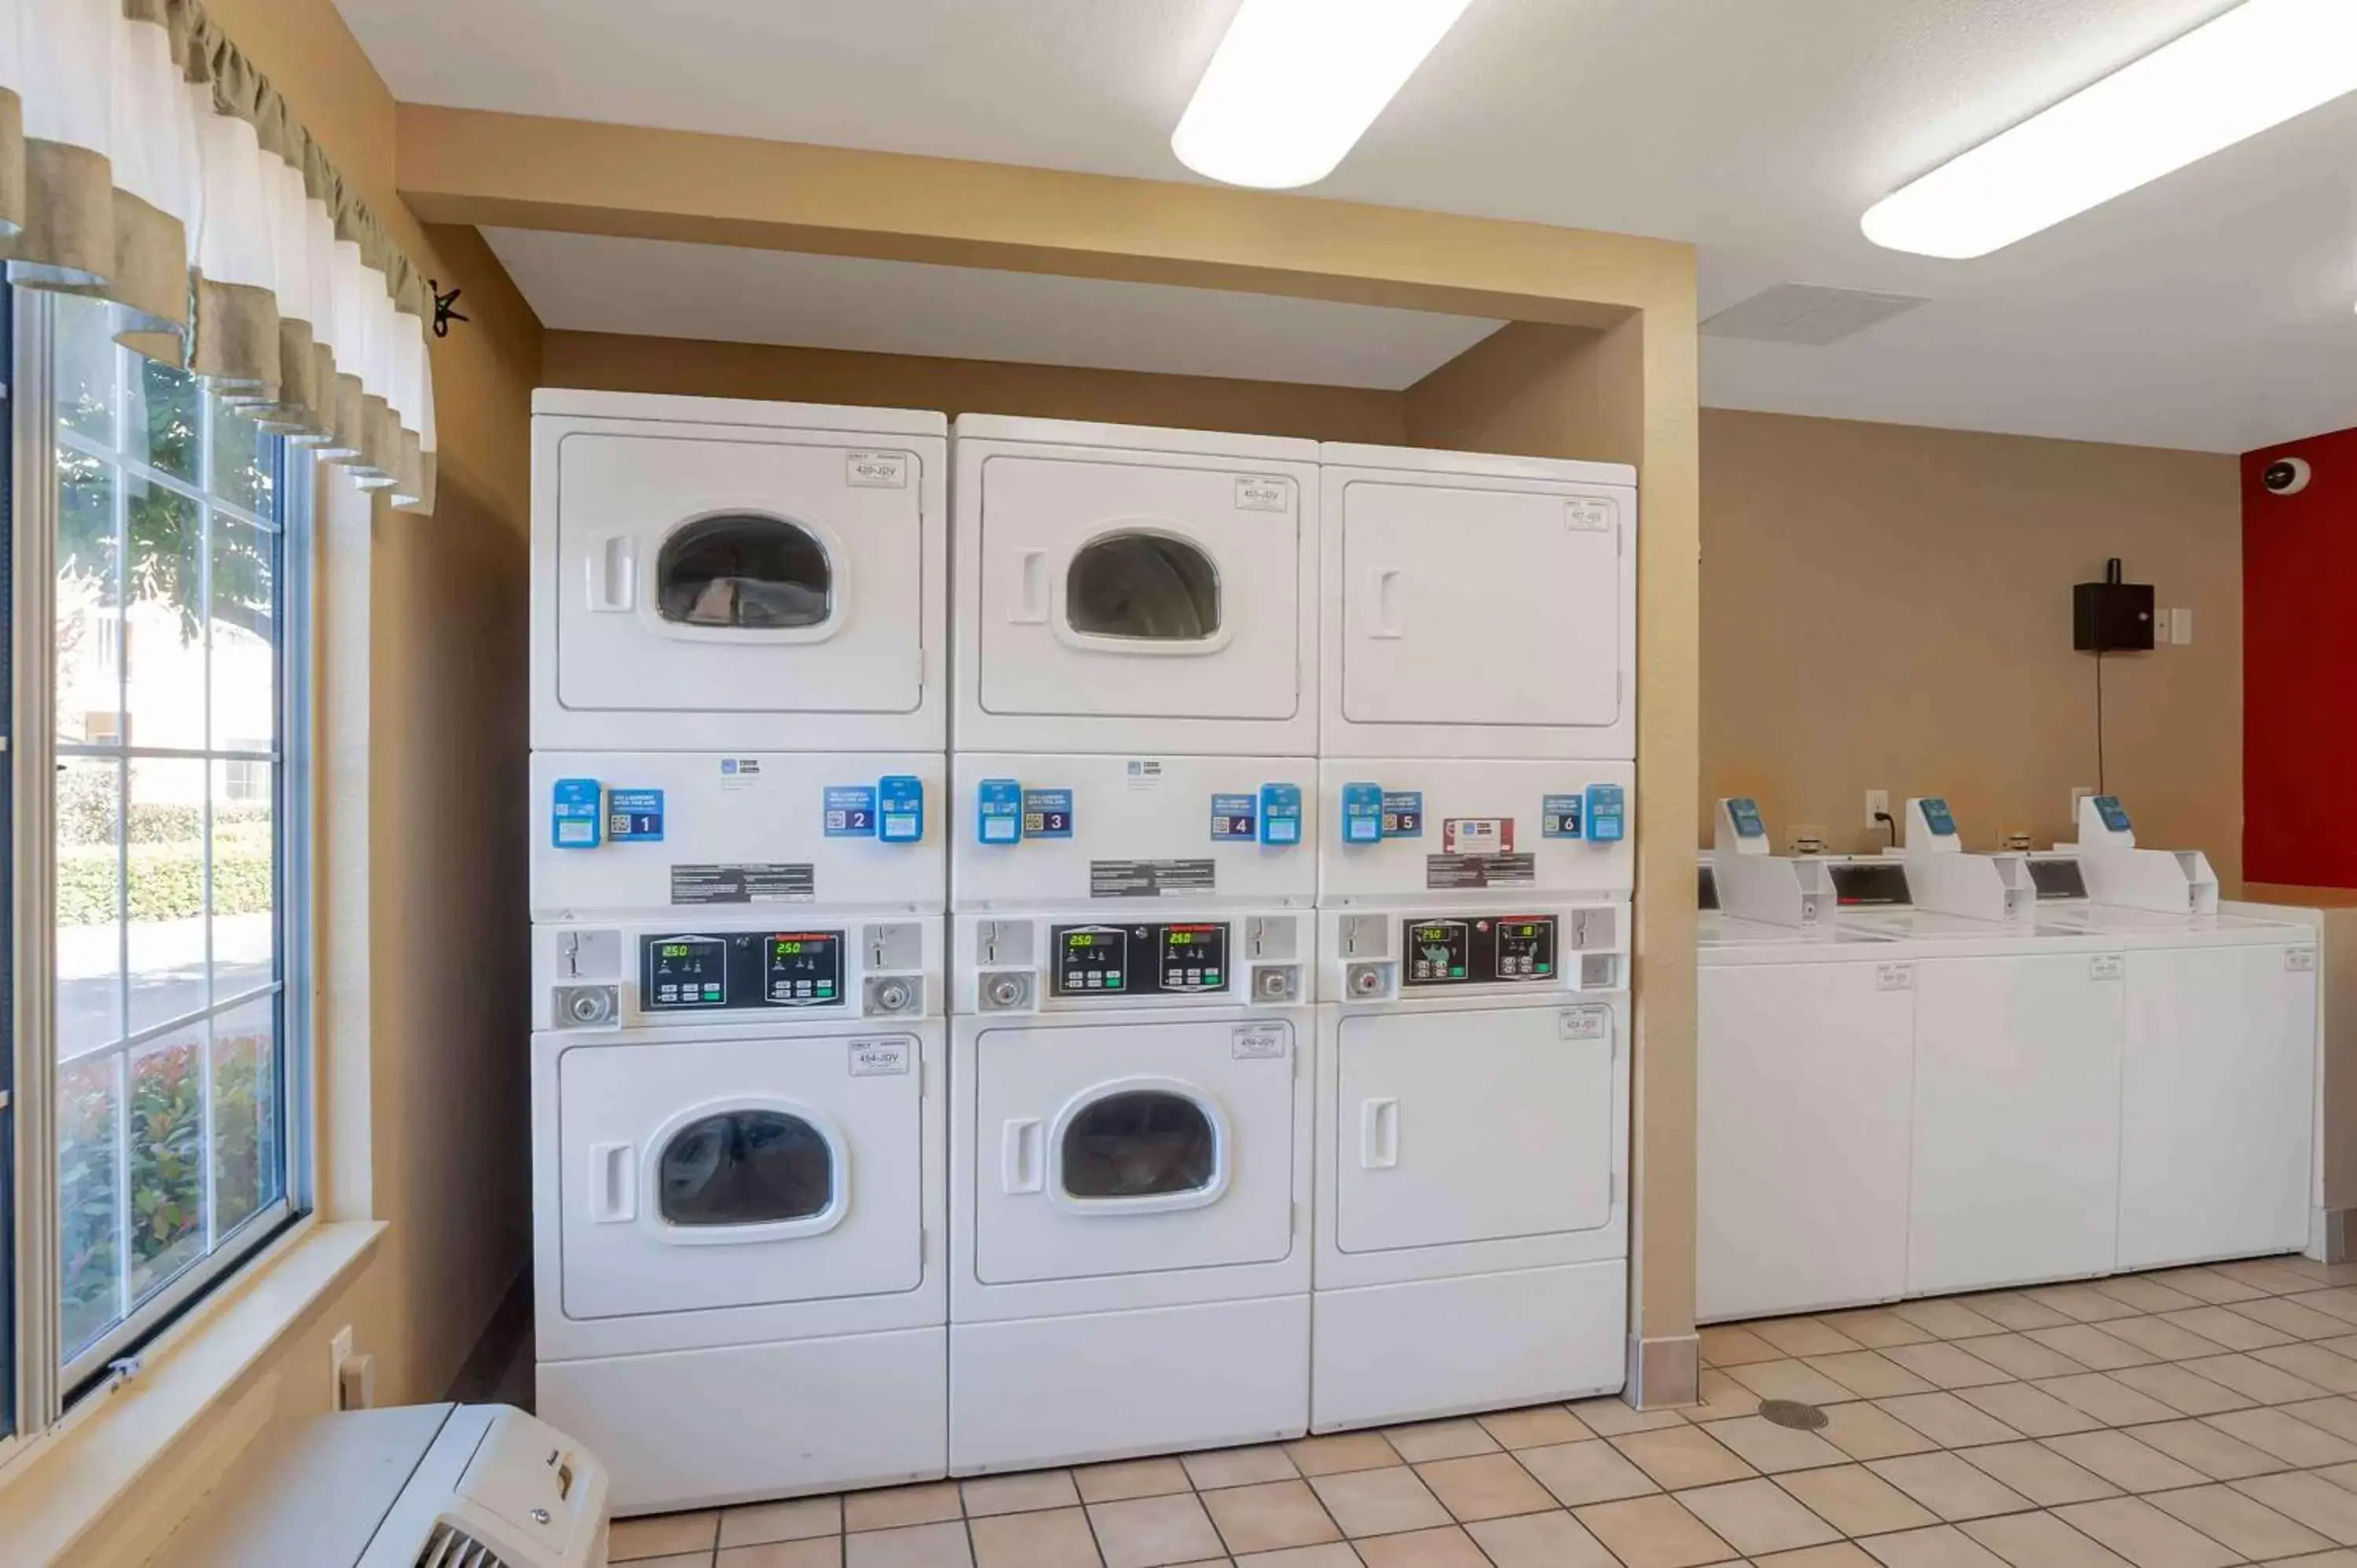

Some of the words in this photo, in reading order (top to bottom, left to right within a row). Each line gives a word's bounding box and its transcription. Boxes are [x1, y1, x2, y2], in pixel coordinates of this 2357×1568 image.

[640, 816, 650, 832] 1
[854, 812, 865, 827] 2
[1051, 815, 1062, 829] 3
[1235, 819, 1248, 833] 4
[1403, 815, 1413, 830] 5
[1564, 817, 1574, 830] 6
